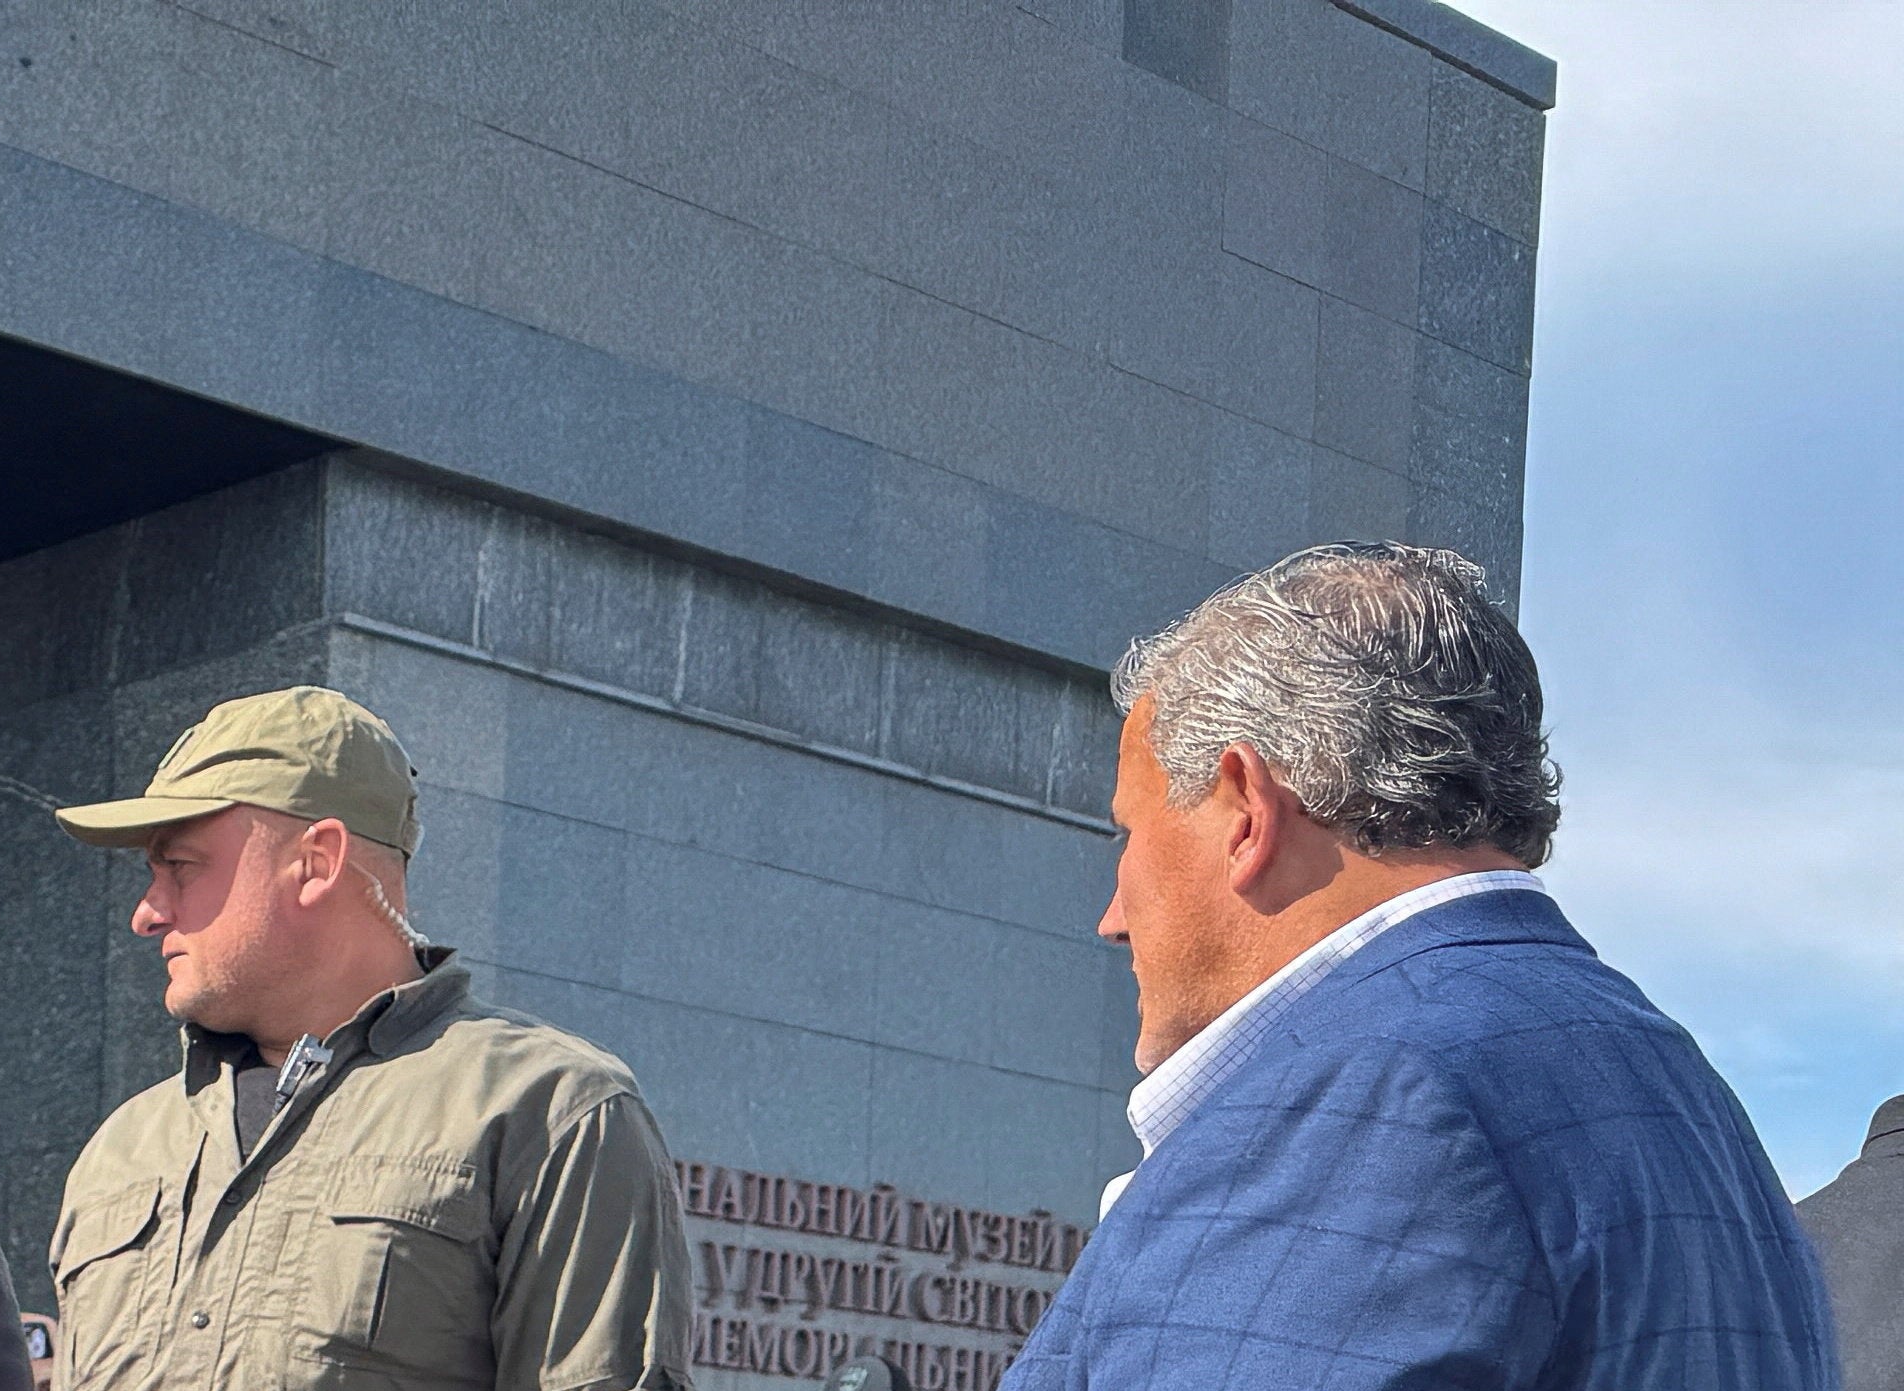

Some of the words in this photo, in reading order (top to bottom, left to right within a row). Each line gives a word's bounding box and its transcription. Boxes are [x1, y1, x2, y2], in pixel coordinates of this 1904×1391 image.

[910, 1201, 1063, 1273] МУЗЕЙ
[700, 1241, 737, 1308] У
[738, 1248, 907, 1320] ДРУГІЙ
[915, 1271, 1055, 1336] СВІТО
